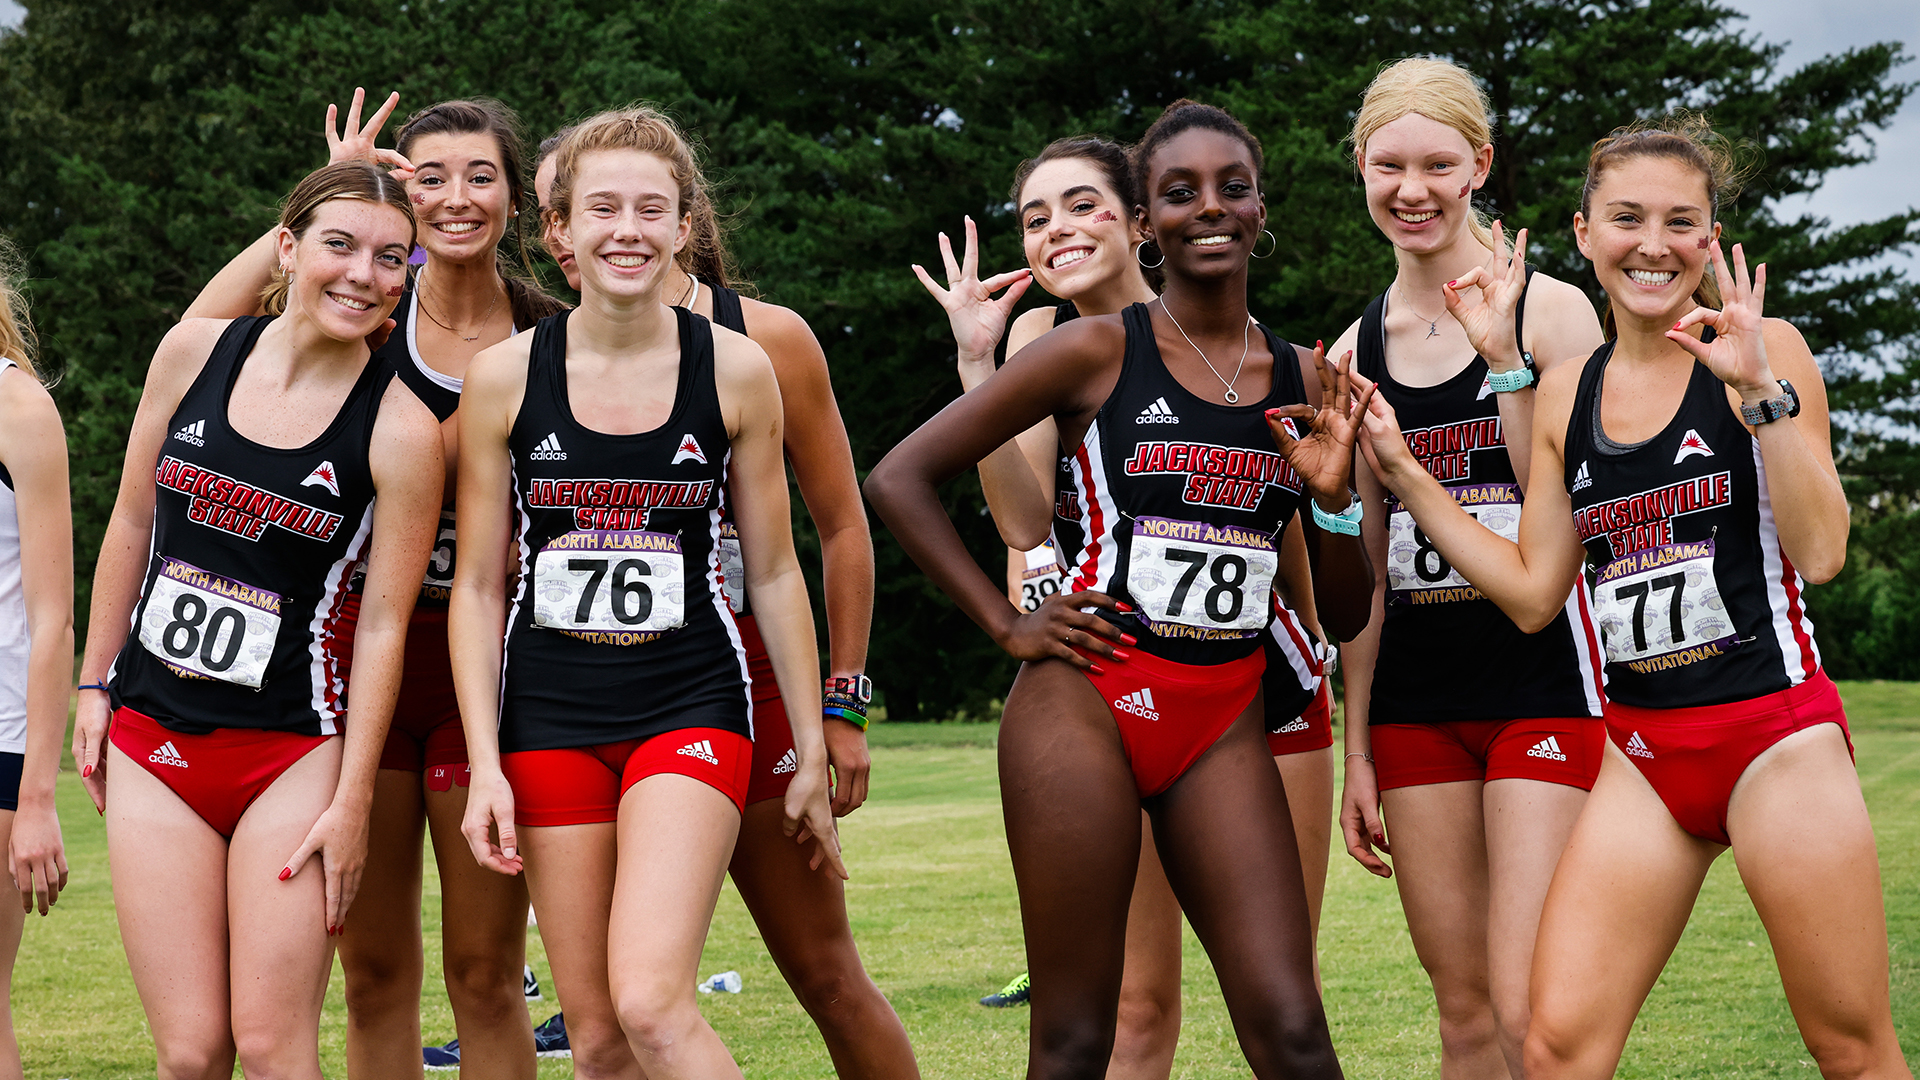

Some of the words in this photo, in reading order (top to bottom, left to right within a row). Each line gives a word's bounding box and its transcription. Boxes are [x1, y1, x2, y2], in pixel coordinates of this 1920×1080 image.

[1136, 413, 1179, 425] adidas
[174, 432, 205, 448] adidas
[530, 450, 567, 461] adidas
[1418, 451, 1471, 482] TATE
[156, 454, 344, 542] JACKSONVILLE
[527, 478, 714, 509] JACKSONVILLE
[1182, 474, 1265, 511] STATE
[1448, 486, 1516, 504] LABAMA
[188, 494, 271, 542] STATE
[574, 505, 651, 531] STATE
[547, 534, 598, 549] NORTH
[602, 534, 679, 552] ALABAMA
[1143, 520, 1200, 540] NORTH
[1204, 527, 1272, 549] ALABAMA
[1609, 516, 1672, 558] STATE
[426, 518, 456, 581] 5
[1640, 544, 1709, 570] ALABAMA
[165, 561, 210, 589] NORTH
[210, 578, 281, 614] ALABAMA
[567, 558, 653, 625] 76
[1022, 578, 1063, 613] 39
[1164, 547, 1247, 623] 78
[1411, 588, 1489, 605] INVITATION
[1615, 571, 1686, 653] 77
[163, 593, 247, 672] 80
[1149, 622, 1243, 641] INVITATIONAL
[1629, 643, 1725, 675] INVITATIONAL
[1114, 699, 1160, 722] adidas
[149, 753, 188, 769] adidas
[677, 747, 719, 766] adidas
[1526, 748, 1567, 762] adidas
[1626, 745, 1655, 760] adidas
[772, 762, 797, 775] adid
